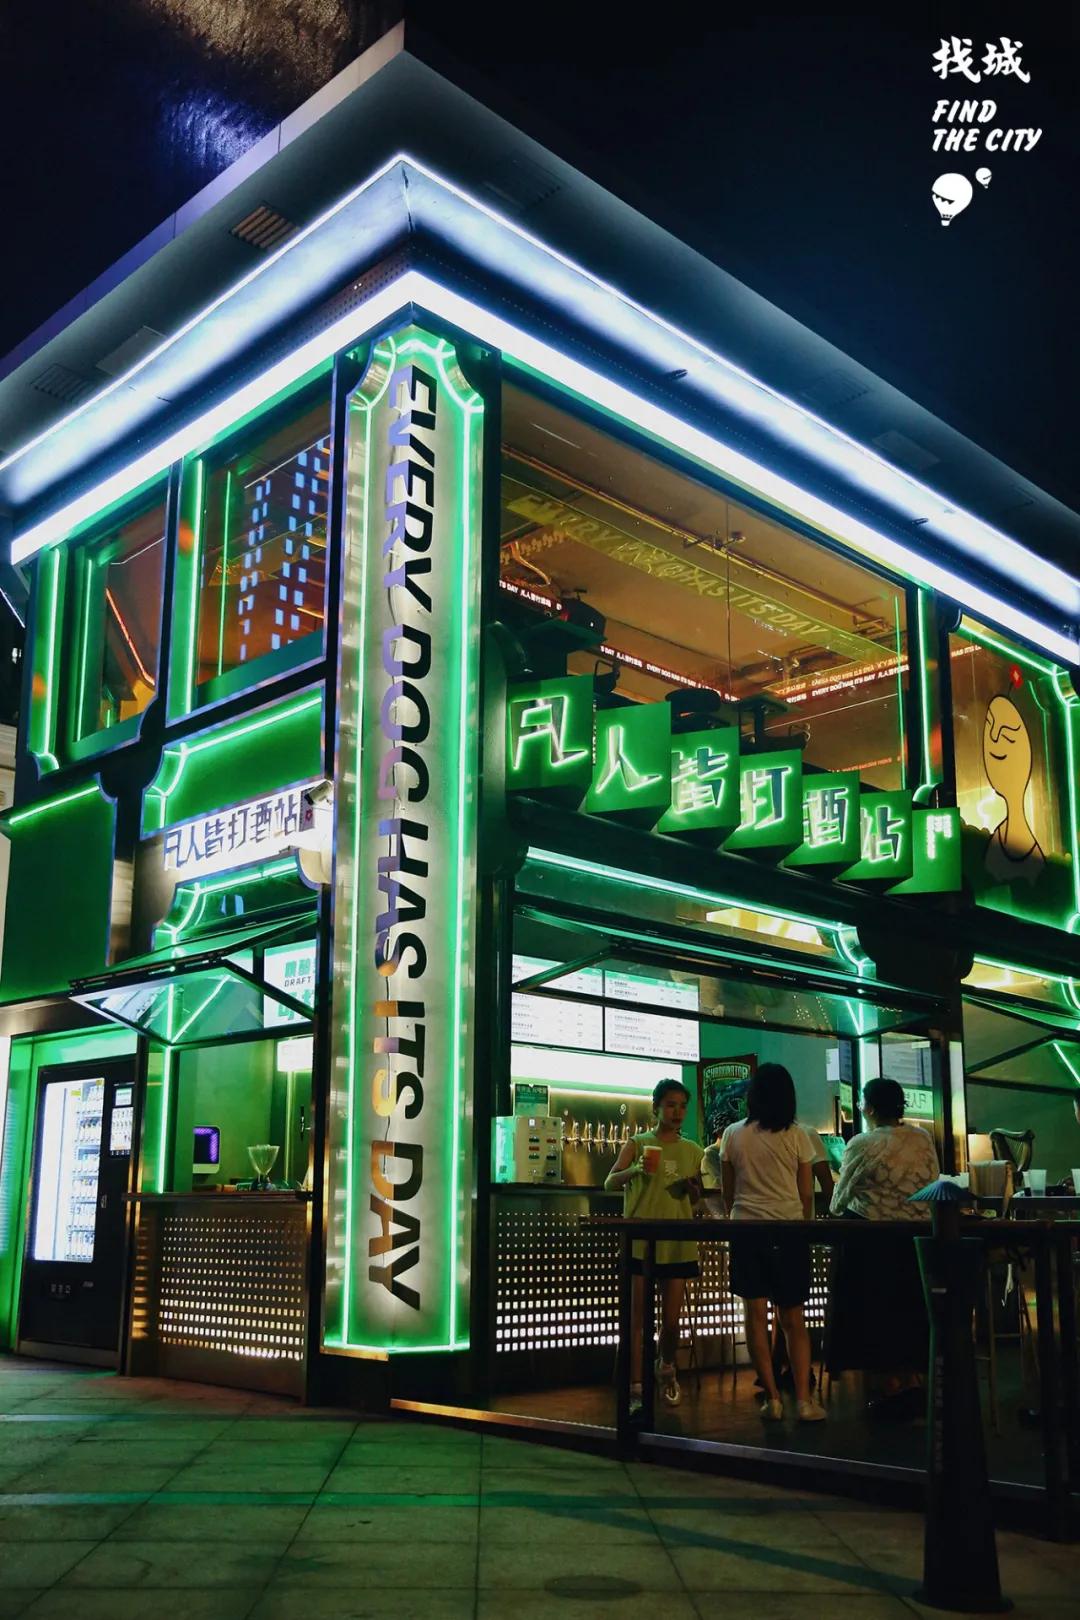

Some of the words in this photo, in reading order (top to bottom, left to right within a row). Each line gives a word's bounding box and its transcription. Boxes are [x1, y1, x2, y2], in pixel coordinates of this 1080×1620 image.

[383, 364, 438, 614] EVERY
[767, 612, 828, 636] DAY
[377, 622, 432, 803] DOG
[373, 818, 430, 980] HAS
[283, 975, 312, 988] DRAFT
[370, 1000, 425, 1121] ITS
[367, 1140, 424, 1312] DAY
